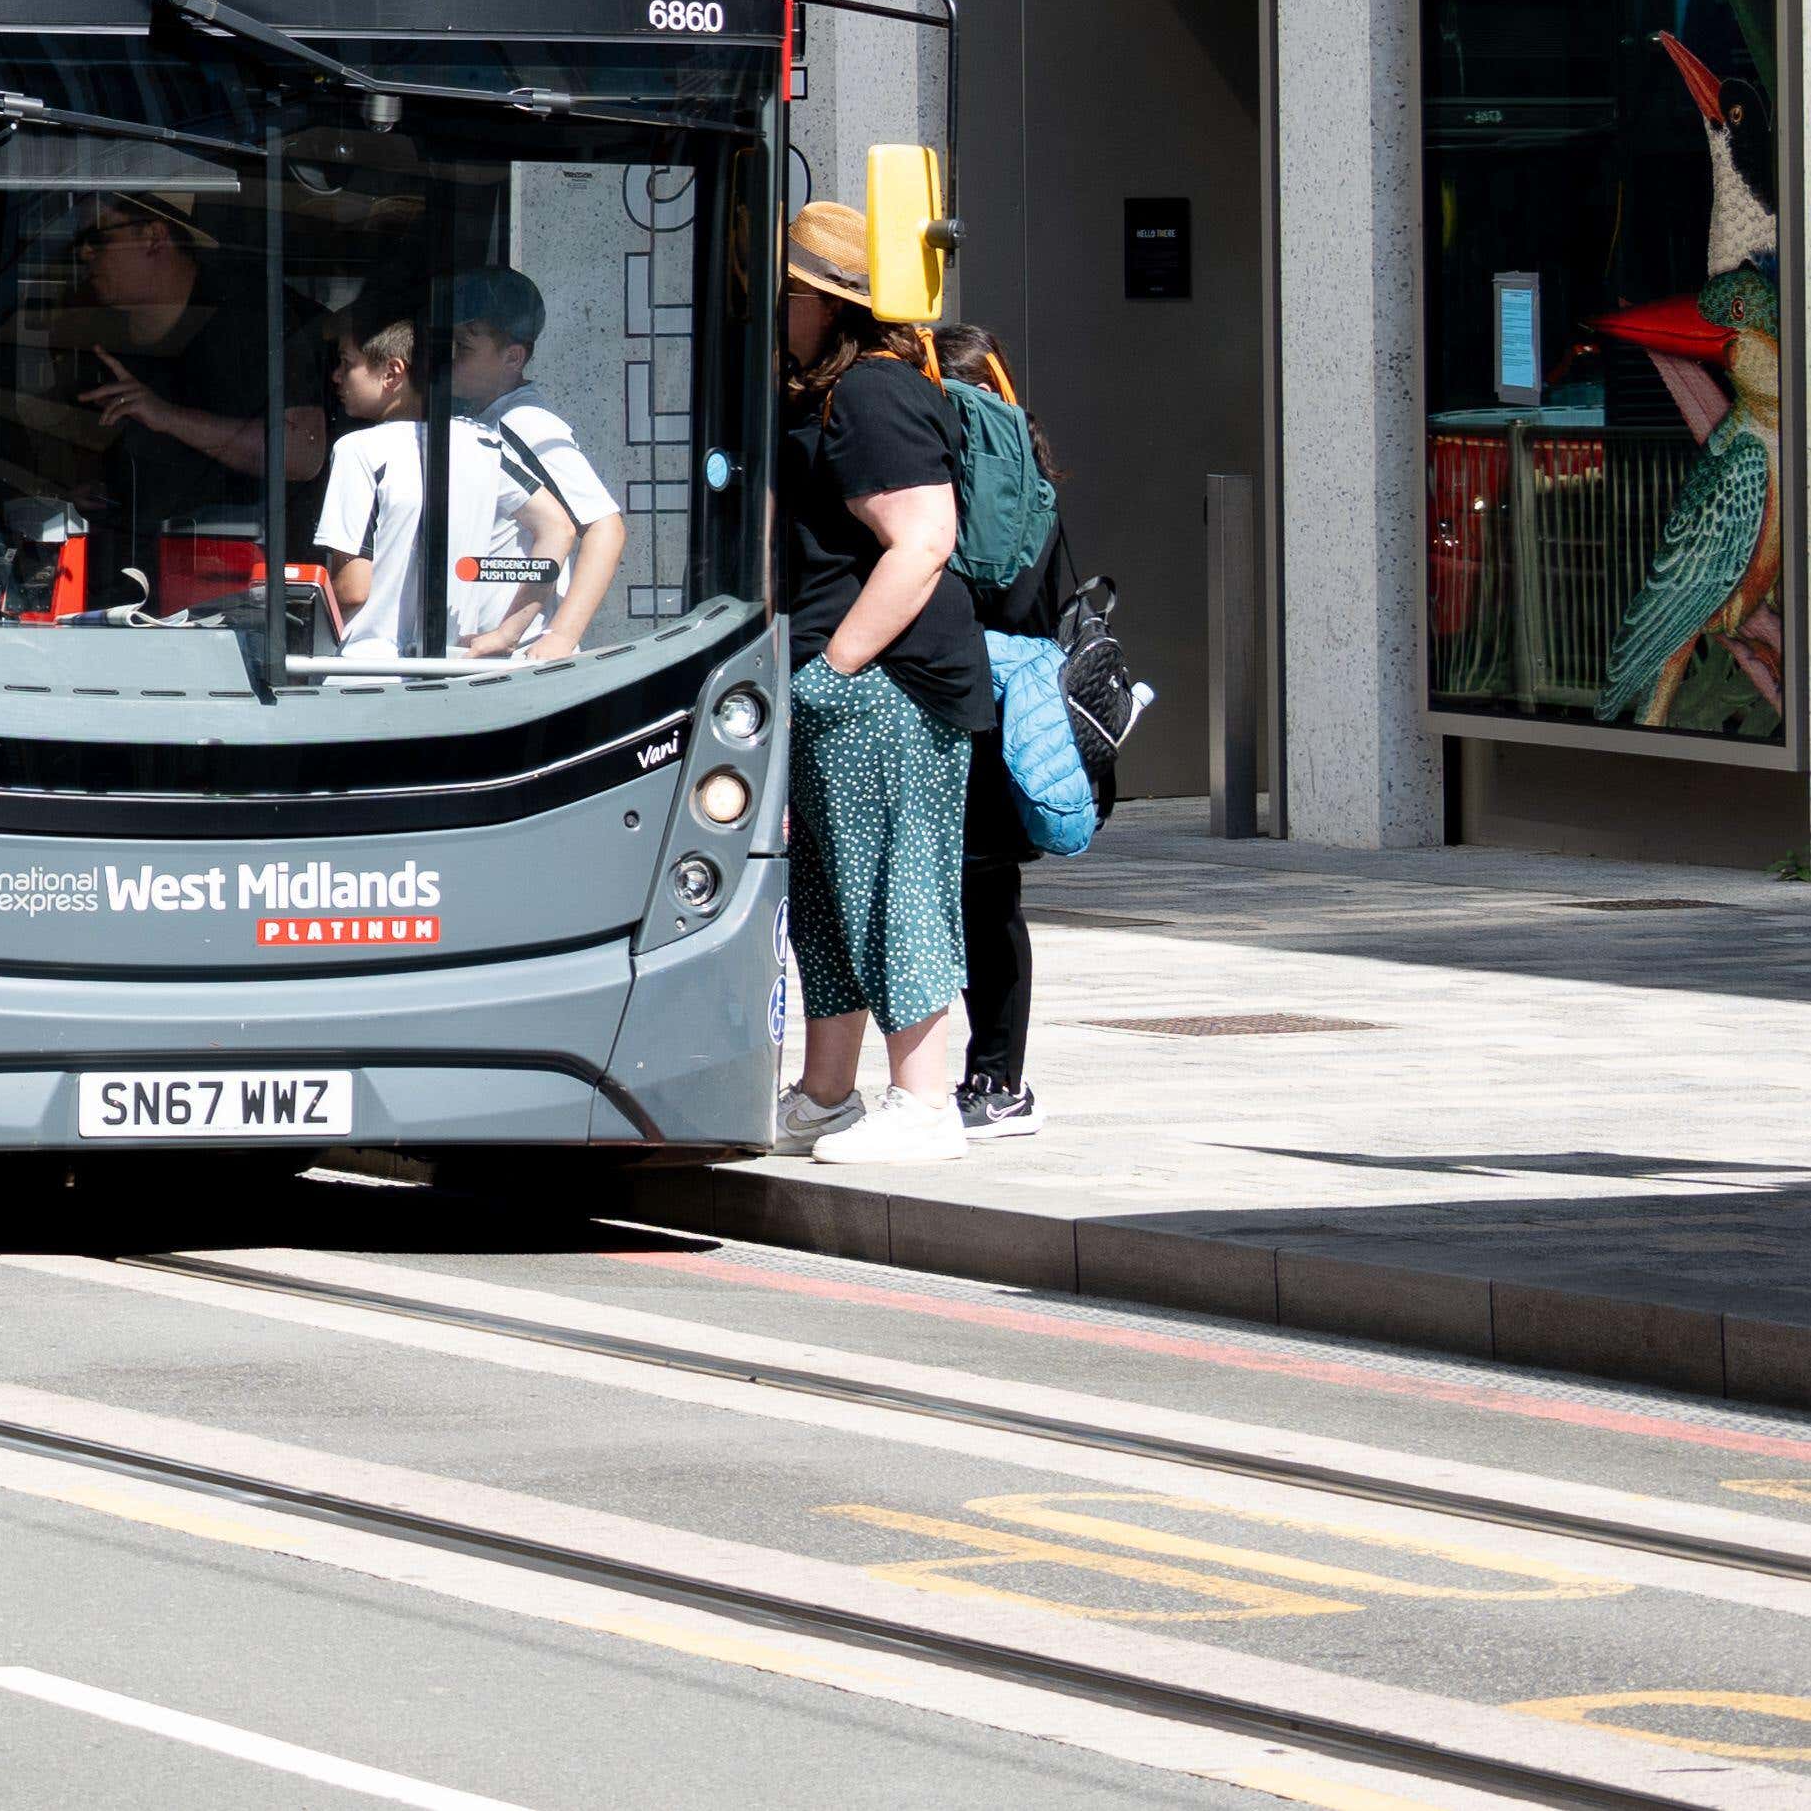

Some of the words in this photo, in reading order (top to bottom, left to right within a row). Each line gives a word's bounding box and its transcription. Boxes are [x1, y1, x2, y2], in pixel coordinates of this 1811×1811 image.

[648, 0, 724, 33] 6860
[479, 560, 530, 570] EMERGENCY
[532, 560, 551, 570] EXIT
[479, 571, 504, 581] PUSH
[505, 572, 516, 581] TO
[517, 571, 541, 581] OPEN
[636, 730, 679, 769] Vani
[104, 864, 226, 911] West
[237, 860, 441, 910] Midlands
[264, 920, 433, 942] PLATINUM
[101, 1081, 224, 1126] SN67
[241, 1080, 329, 1125] WWZ
